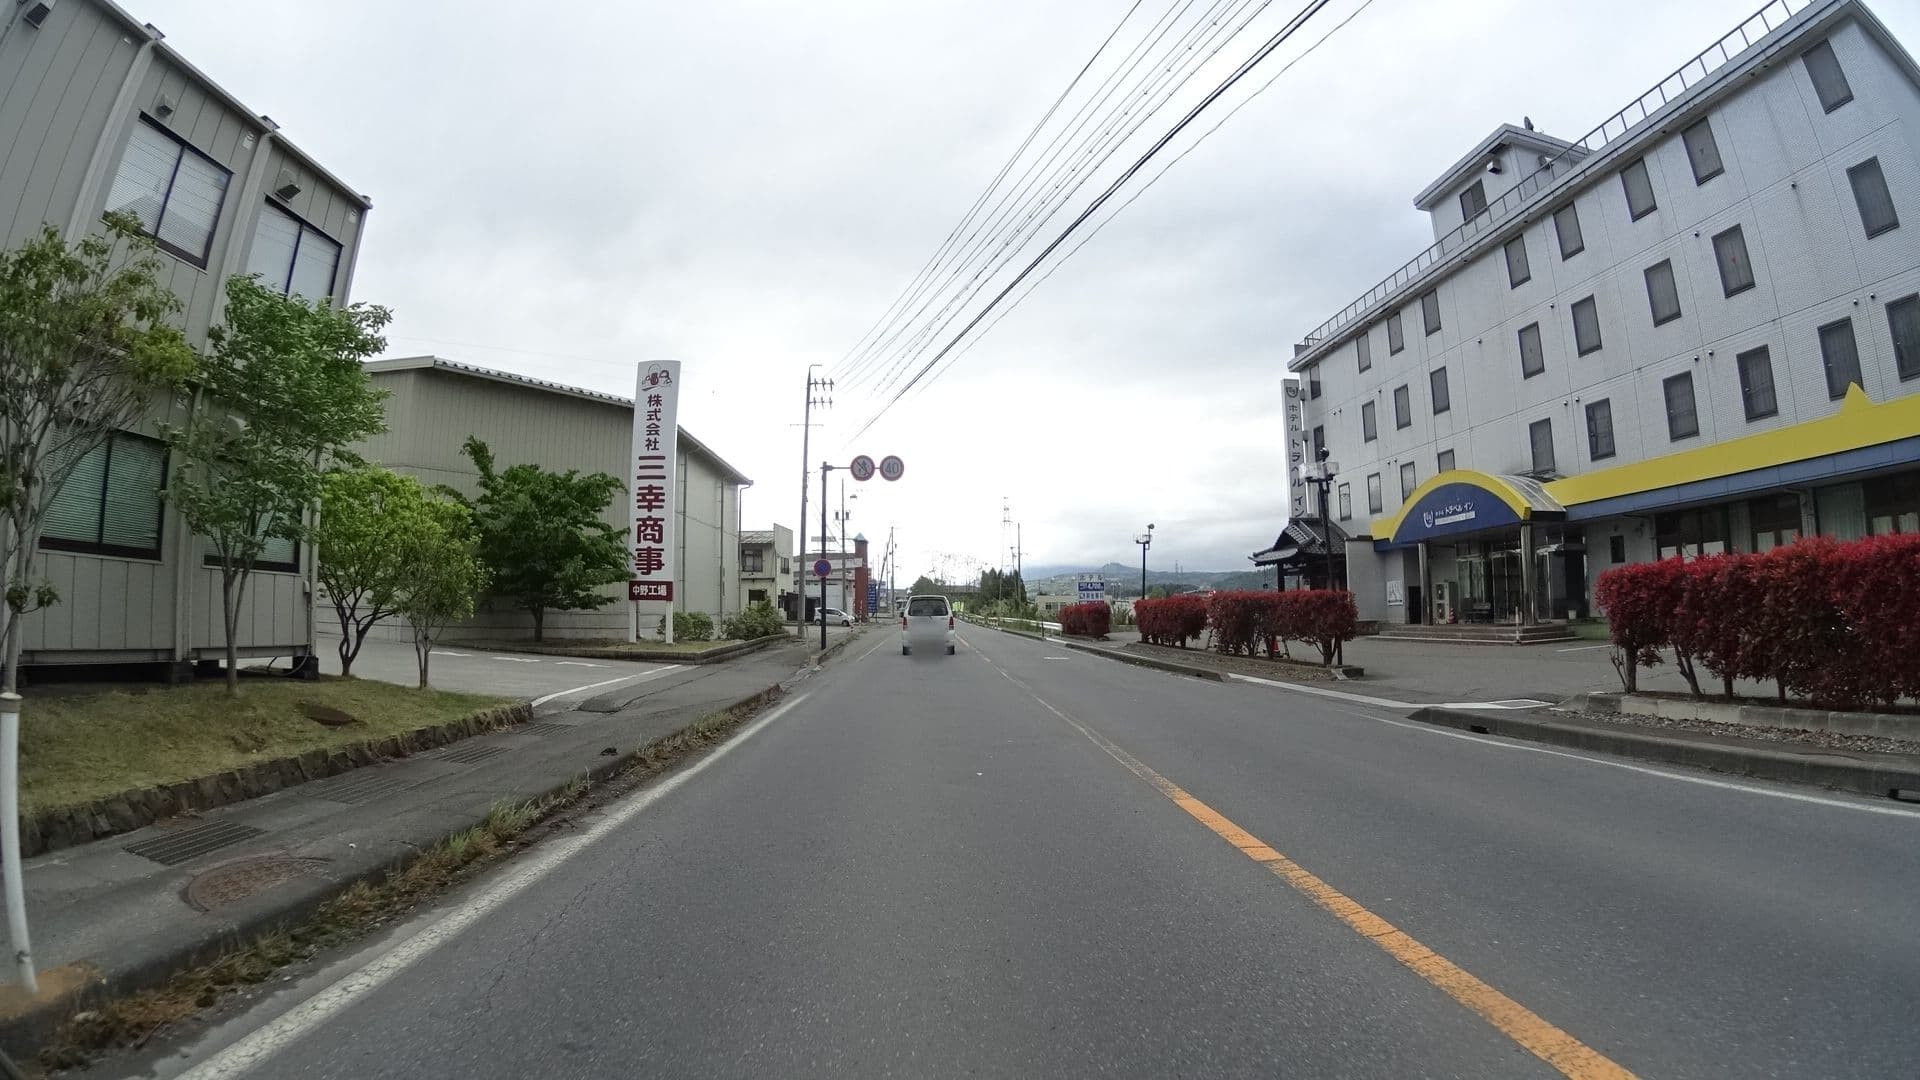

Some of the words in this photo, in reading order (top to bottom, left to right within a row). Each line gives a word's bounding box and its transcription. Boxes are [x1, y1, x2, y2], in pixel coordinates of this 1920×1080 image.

[644, 394, 663, 451] 株式会社
[1289, 405, 1300, 432] ホテル
[885, 462, 900, 474] 40
[635, 455, 666, 576] 三幸商事
[1294, 496, 1305, 518] イン
[632, 585, 668, 597] 中野工場
